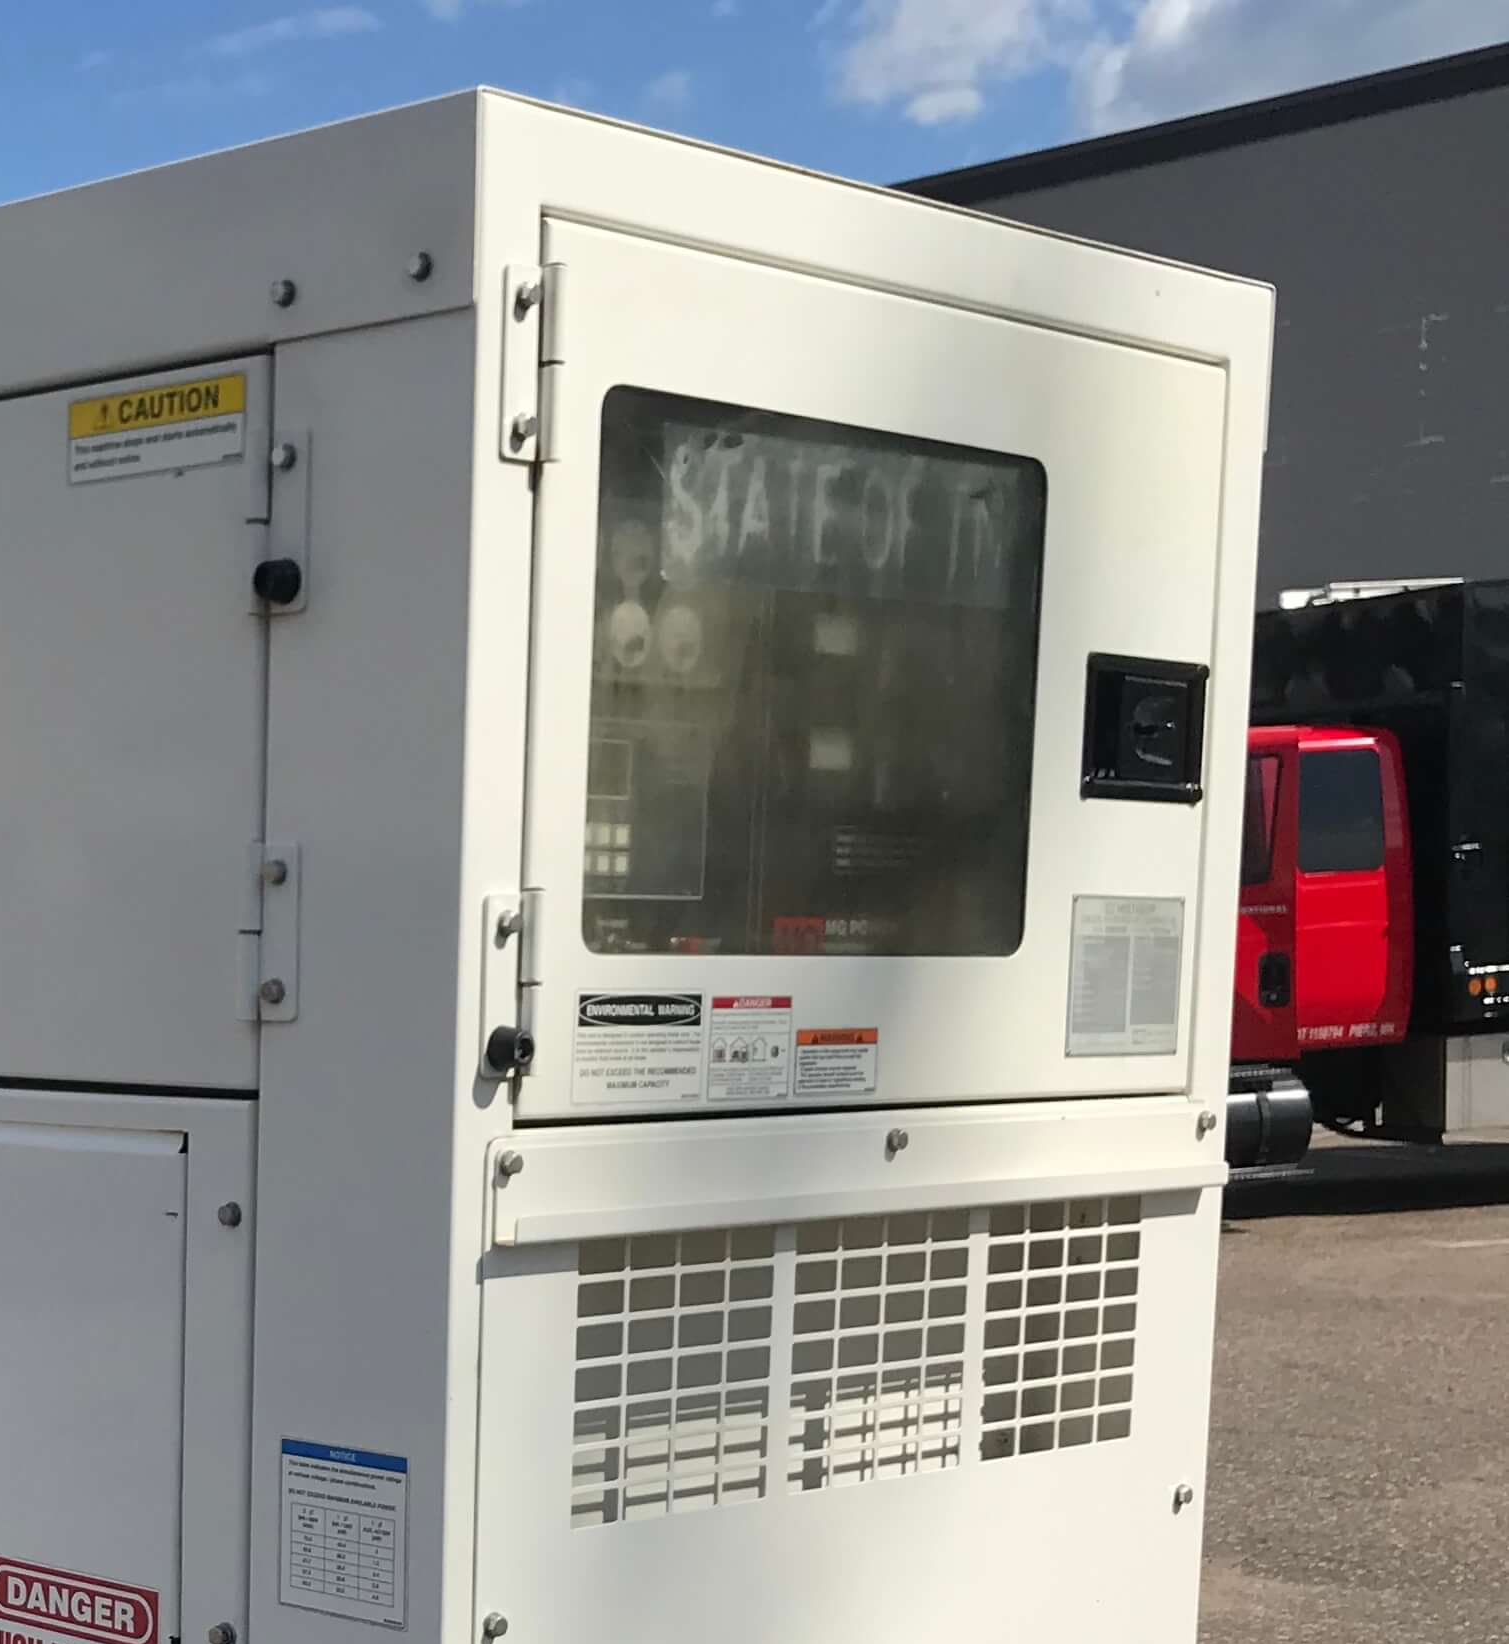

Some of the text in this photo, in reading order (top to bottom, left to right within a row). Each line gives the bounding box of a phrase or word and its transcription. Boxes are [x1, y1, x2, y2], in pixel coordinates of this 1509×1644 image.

[118, 385, 219, 424] CAUTION
[586, 1004, 695, 1016] ENVIRONMENTAL WARNING
[7, 1575, 135, 1633] DANGER
